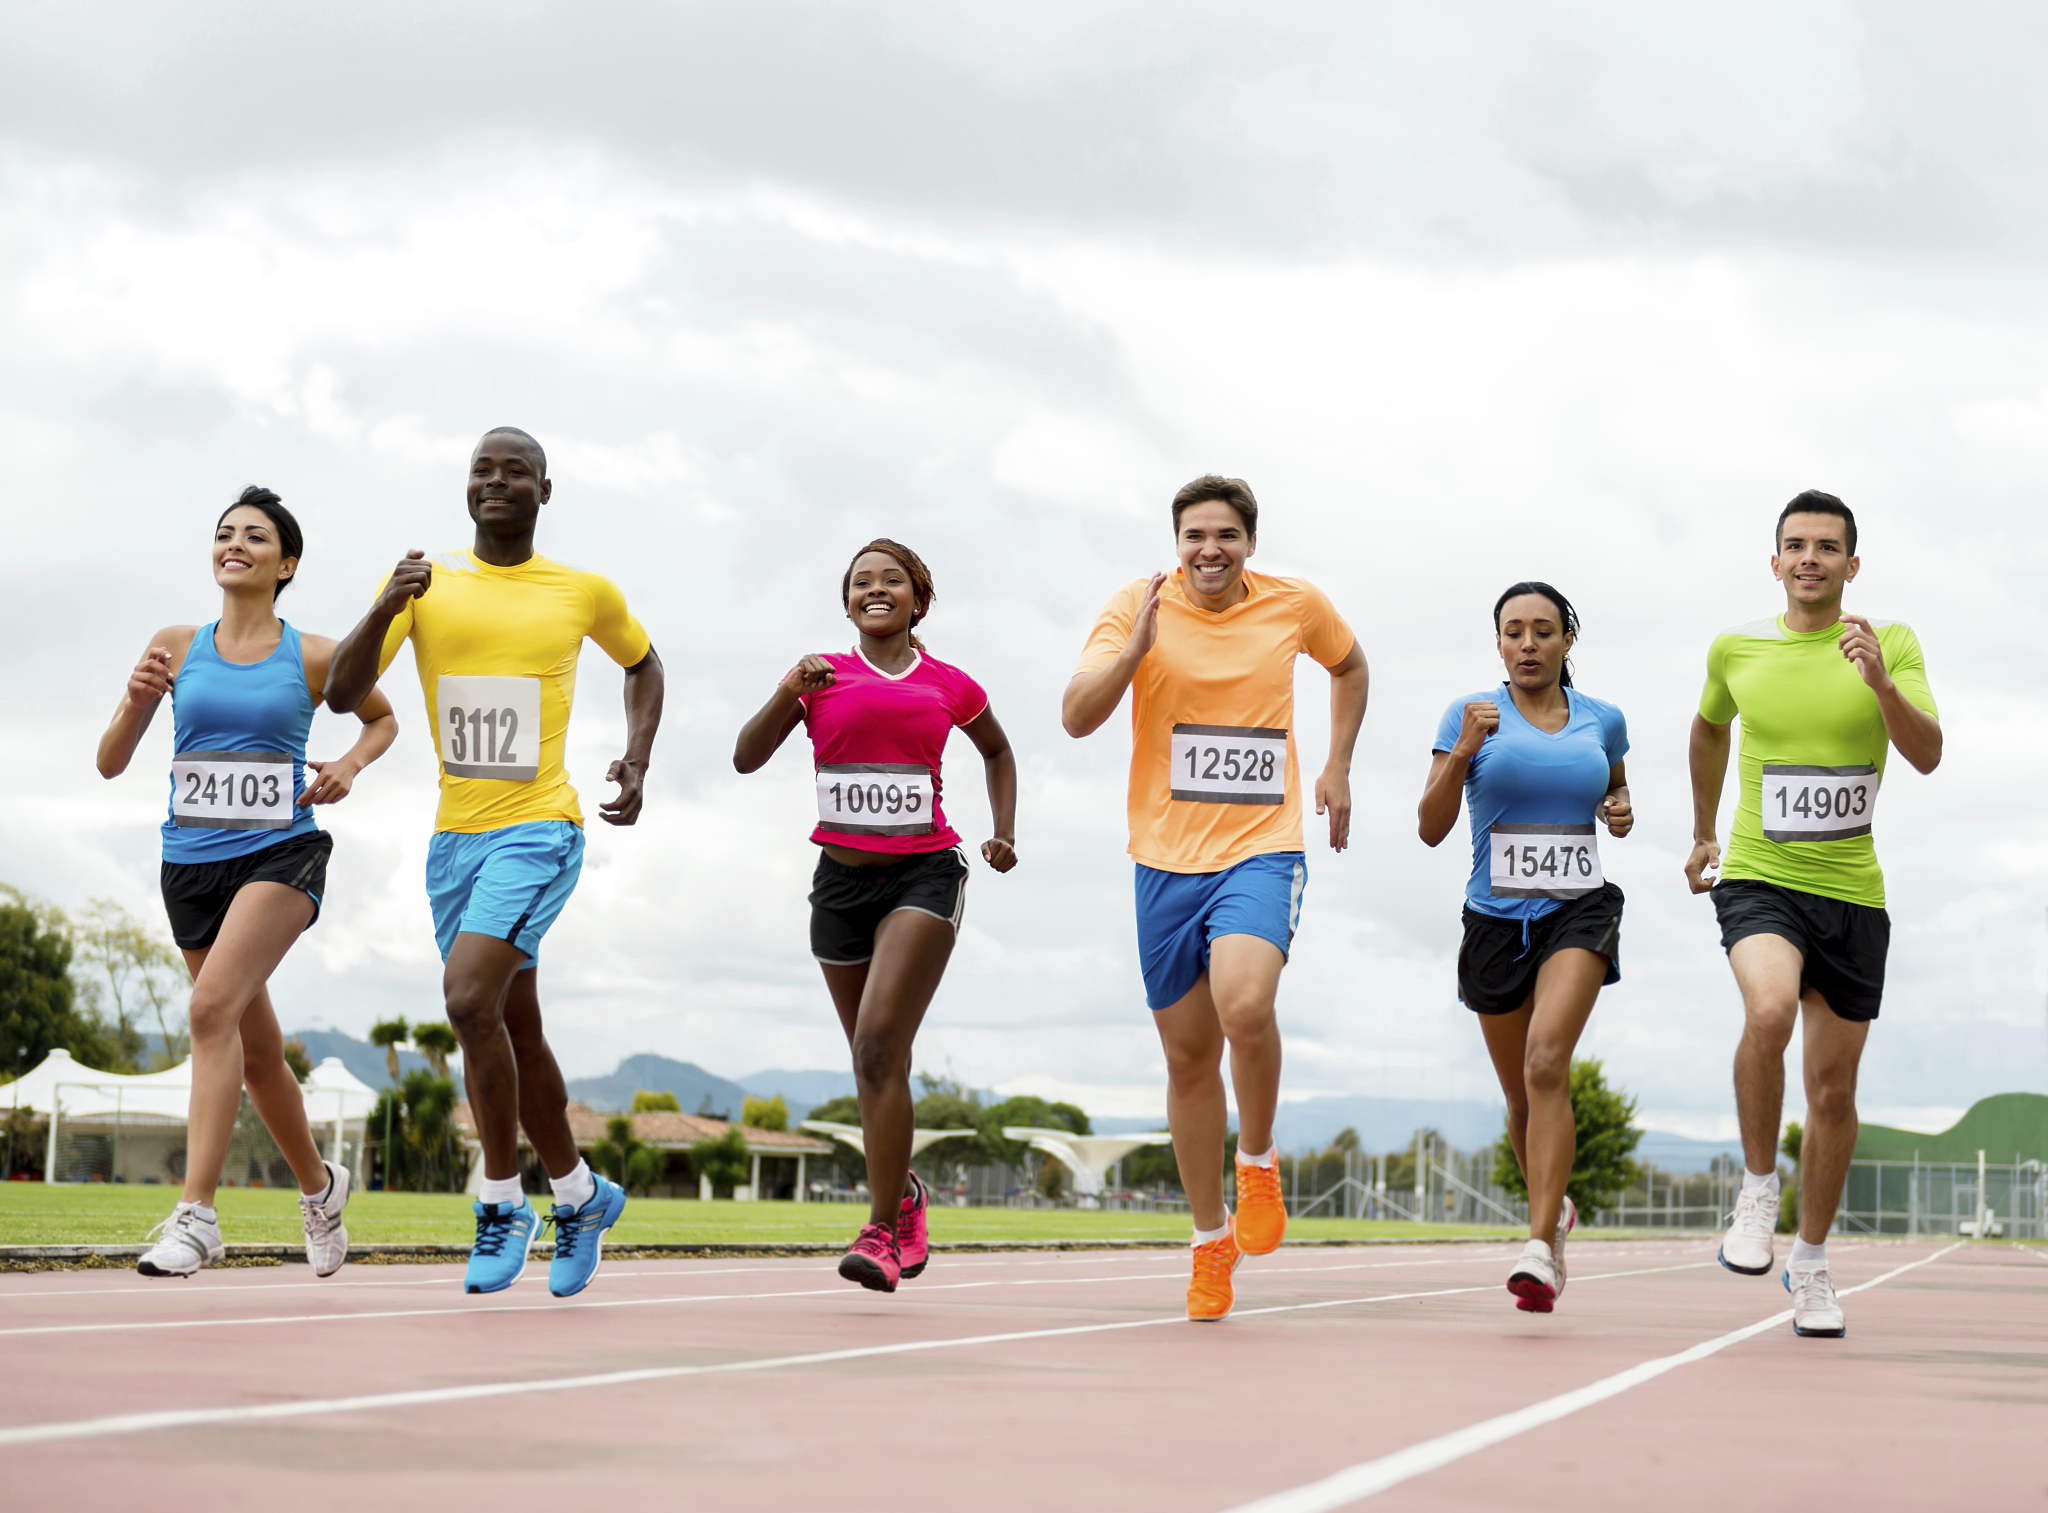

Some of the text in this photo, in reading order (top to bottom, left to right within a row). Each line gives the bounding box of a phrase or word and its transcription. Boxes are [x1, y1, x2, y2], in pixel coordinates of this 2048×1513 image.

[449, 707, 519, 763] 3112
[1184, 746, 1275, 783] 12528
[182, 772, 281, 808] 24103
[829, 782, 922, 815] 10095
[1775, 784, 1868, 819] 14903
[1503, 844, 1593, 878] 15476
